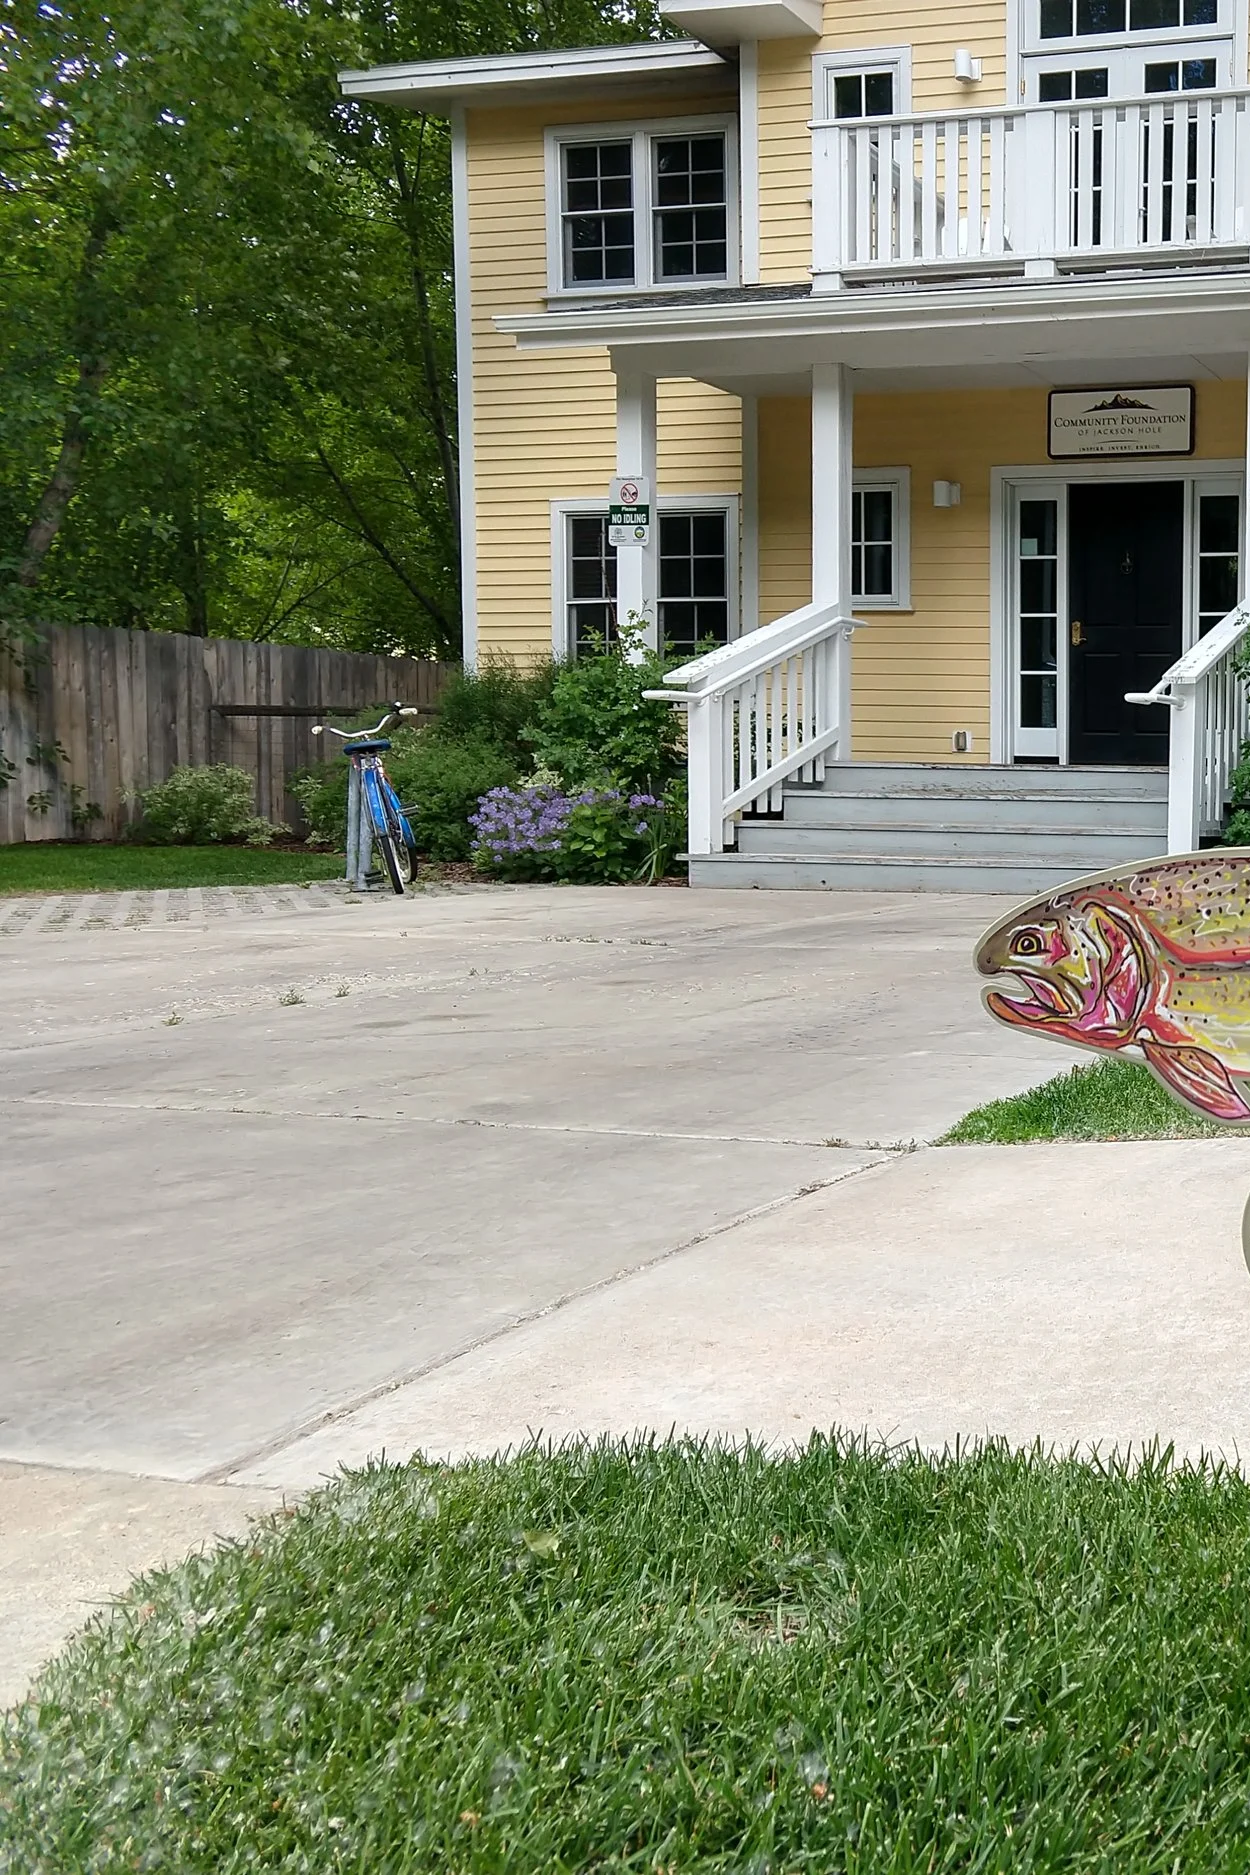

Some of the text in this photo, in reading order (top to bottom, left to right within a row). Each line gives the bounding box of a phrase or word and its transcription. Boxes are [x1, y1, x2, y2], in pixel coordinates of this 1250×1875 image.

[1054, 414, 1187, 428] COMMUNITY FOUNDATION
[1093, 427, 1134, 436] JACKSON
[1138, 426, 1162, 434] HOLE
[611, 513, 646, 524] NO IDLING
